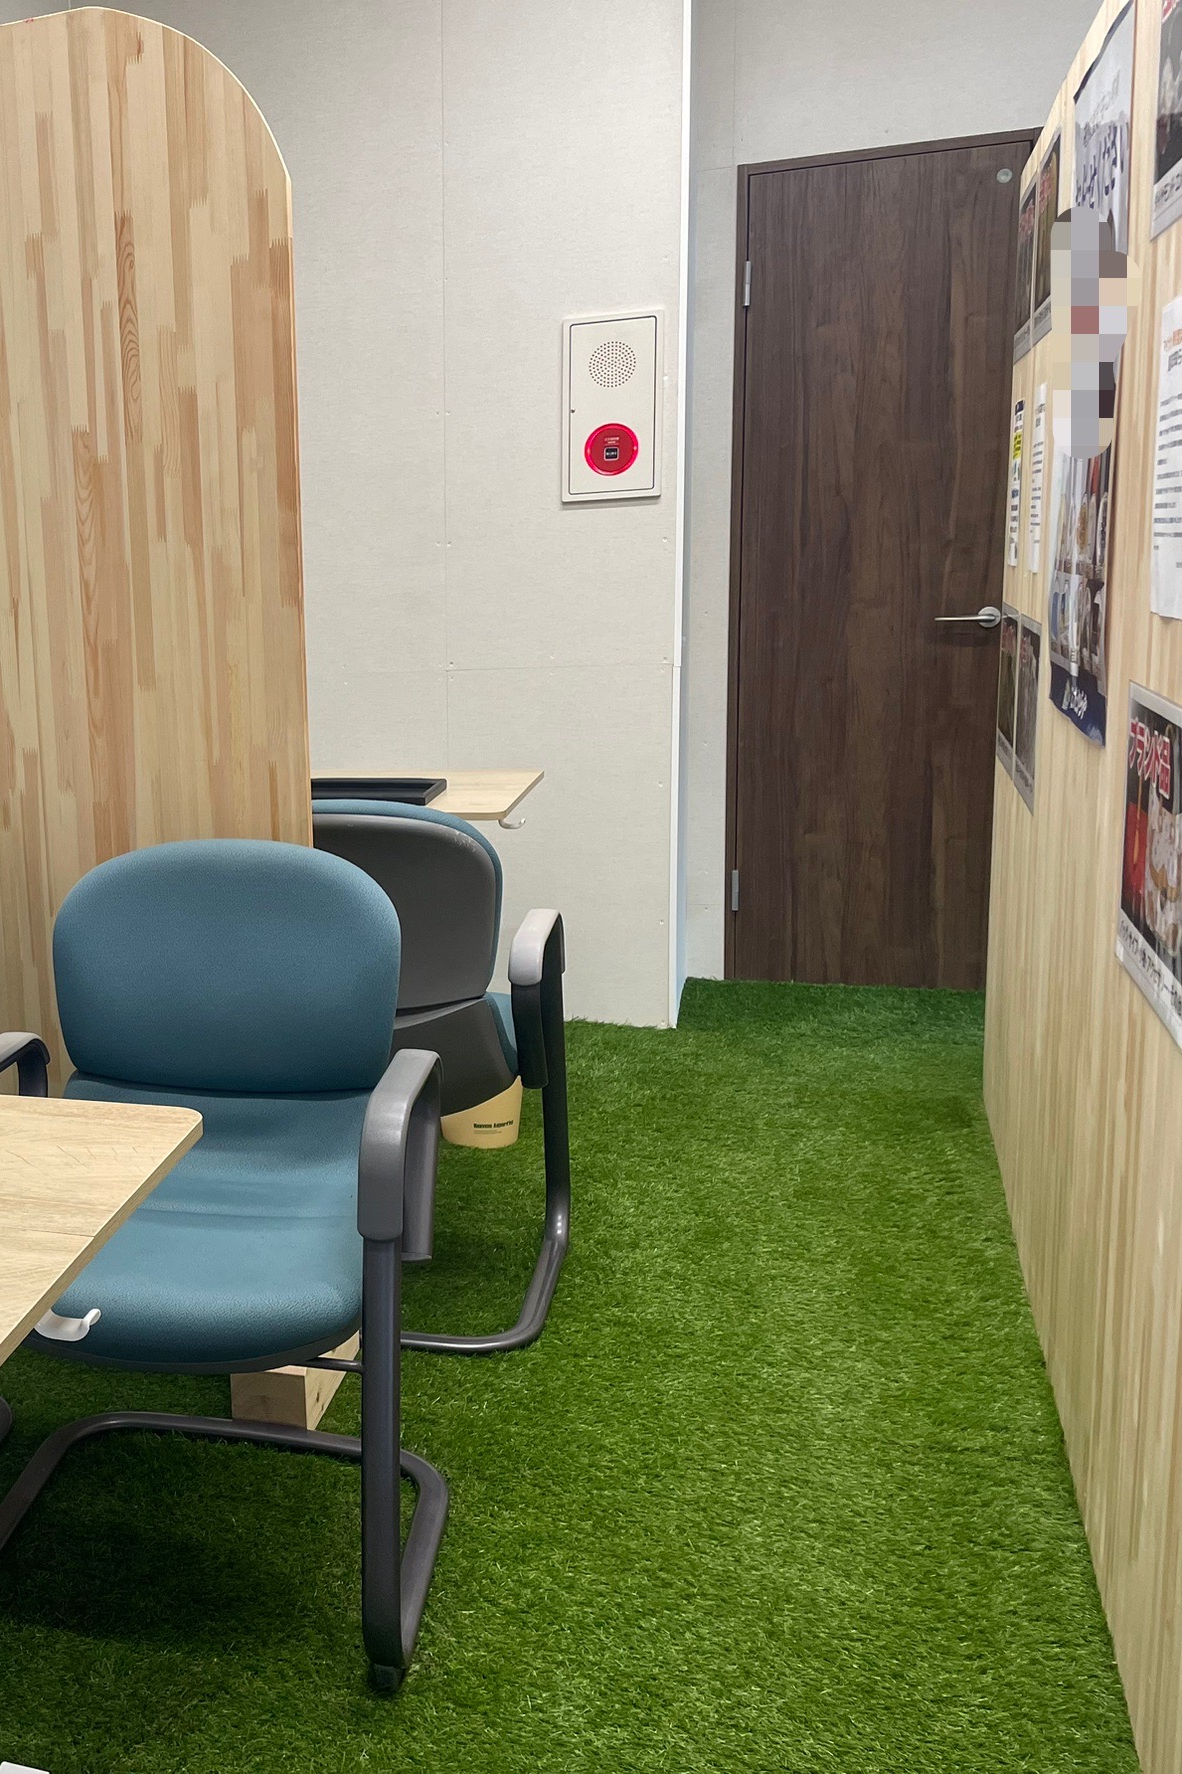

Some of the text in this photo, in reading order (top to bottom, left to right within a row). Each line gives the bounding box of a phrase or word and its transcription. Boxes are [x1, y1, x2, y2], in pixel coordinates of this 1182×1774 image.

[1130, 717, 1170, 800] ブランド品
